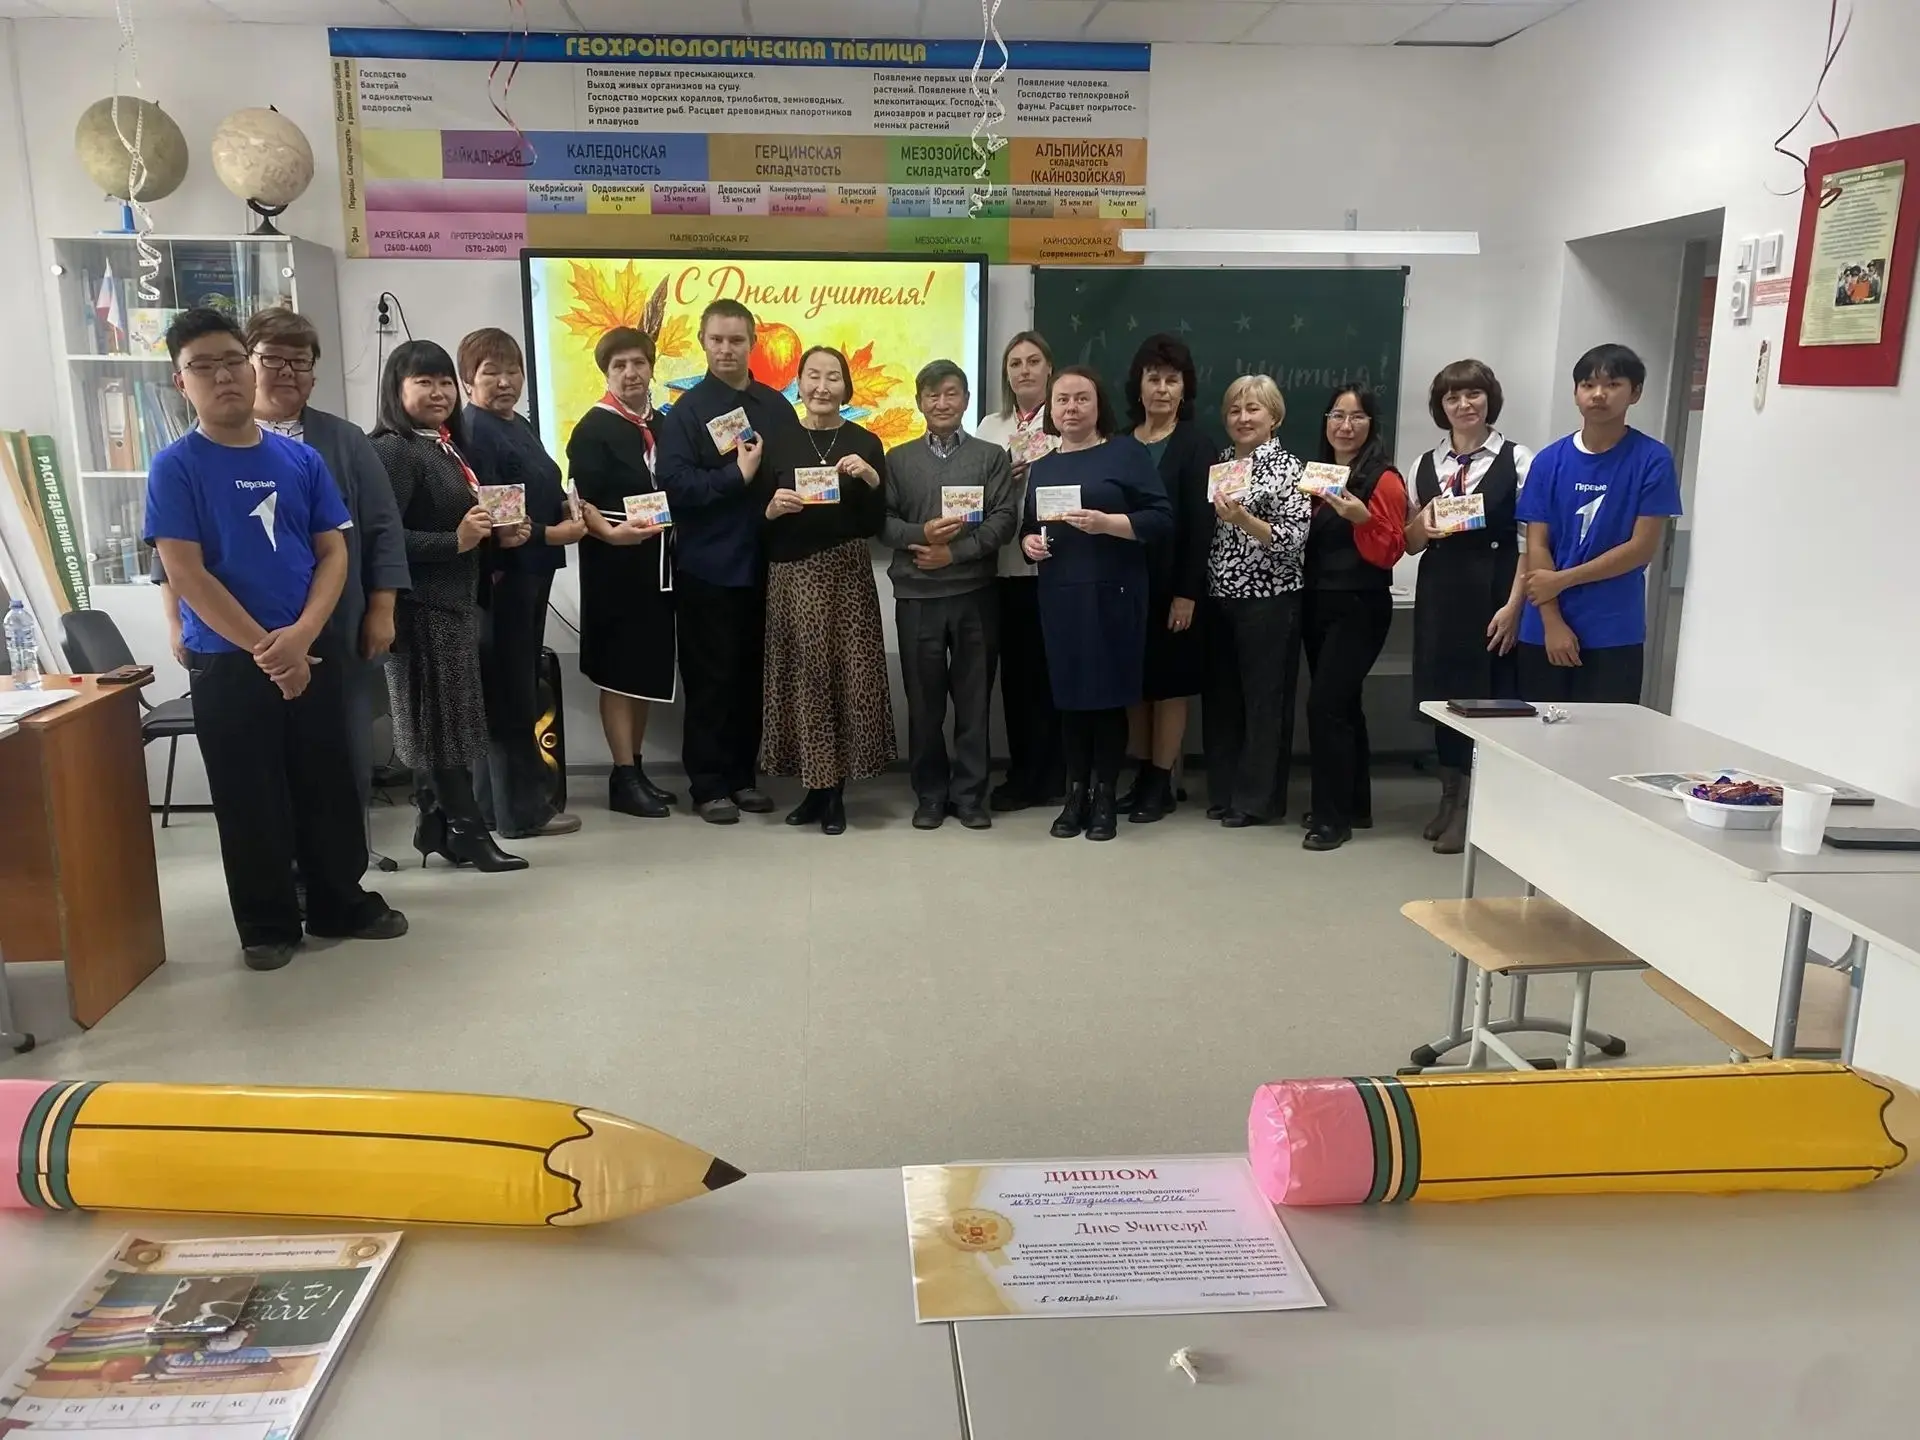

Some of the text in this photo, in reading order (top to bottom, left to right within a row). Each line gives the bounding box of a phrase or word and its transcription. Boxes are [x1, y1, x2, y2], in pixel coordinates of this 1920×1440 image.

[565, 37, 927, 64] ГЕОХРОНОЛОГИЧЕСКАЯ ТАБЛИЦА
[360, 70, 407, 78] Господство
[586, 68, 756, 80] Появление первых пресмыкающихся.
[874, 73, 1004, 84] Появление первых цвткох
[360, 80, 399, 90] бактерий
[587, 81, 616, 90] Выход
[618, 82, 648, 90] живых
[650, 83, 702, 92] организмов
[718, 84, 741, 93] сушу.
[1018, 78, 1110, 88] Появление человека.
[874, 84, 916, 94] растений.
[918, 86, 967, 94] Появление
[969, 88, 990, 96] пиц
[1018, 90, 1130, 100] Господство теплокровной
[369, 94, 433, 102] одноклеточных
[588, 93, 844, 106] Господство морских кораллов, трилобитов, земноводных.
[874, 98, 948, 107] млекопитающих.
[362, 105, 412, 113] водорослей
[588, 105, 852, 118] Бурное развитие рыб. Расцвет древовидных папоротников
[1017, 102, 1136, 112] фауны. Расцвет покрытосе-
[874, 110, 926, 119] динозавров
[936, 112, 970, 120] расцвет
[1017, 114, 1092, 124] менных растений
[596, 118, 639, 126] плавунов
[874, 120, 950, 131] менных растений
[566, 144, 667, 161] КАЛЕДОНСКАЯ
[755, 144, 842, 162] ГЕРЦИНСКАЯ
[1036, 140, 1123, 158] АЛЬПИЙСКАЯ
[1049, 159, 1108, 168] складчатость
[574, 164, 662, 177] складчатость
[756, 164, 842, 177] складчатость
[906, 165, 991, 179] складчатось
[1030, 168, 1126, 185] (КАЙНОЗОЙСКАЯ)
[529, 182, 584, 194] Кембрийский
[592, 184, 645, 195] Ордовикский
[654, 184, 706, 195] Силурийский
[718, 184, 761, 195] Девонский
[838, 185, 877, 197] Пермский
[888, 186, 930, 196] Триасовый
[934, 186, 965, 198] Юрский
[1054, 188, 1099, 198] Неогеновый
[351, 227, 360, 243] Эры
[374, 230, 440, 240] АРХЕЙСКАЯ AR
[450, 230, 524, 241] ПРОТЕРОЗОЙСКАЯ PR
[669, 233, 736, 242] ПАЛЕОЗОЙСКАЯ
[915, 236, 970, 245] МЕЗОЗОЙСКАЯ
[1042, 236, 1112, 246] КАЙНОЗОЙСКАЯ KZ
[384, 244, 432, 253] (2600-4600)
[465, 244, 507, 254] (570-2600)
[674, 265, 936, 320] С Днем учителя!
[235, 480, 276, 490] Первые
[1574, 482, 1608, 492] Первые
[38, 456, 91, 611] РАСПРЕДЕЛЕНИЕ СОЛНЕЧН
[1044, 1168, 1160, 1184] ДИПЛОМ
[1074, 1220, 1208, 1236] Дню Учителя!
[250, 1280, 332, 1302] ack to
